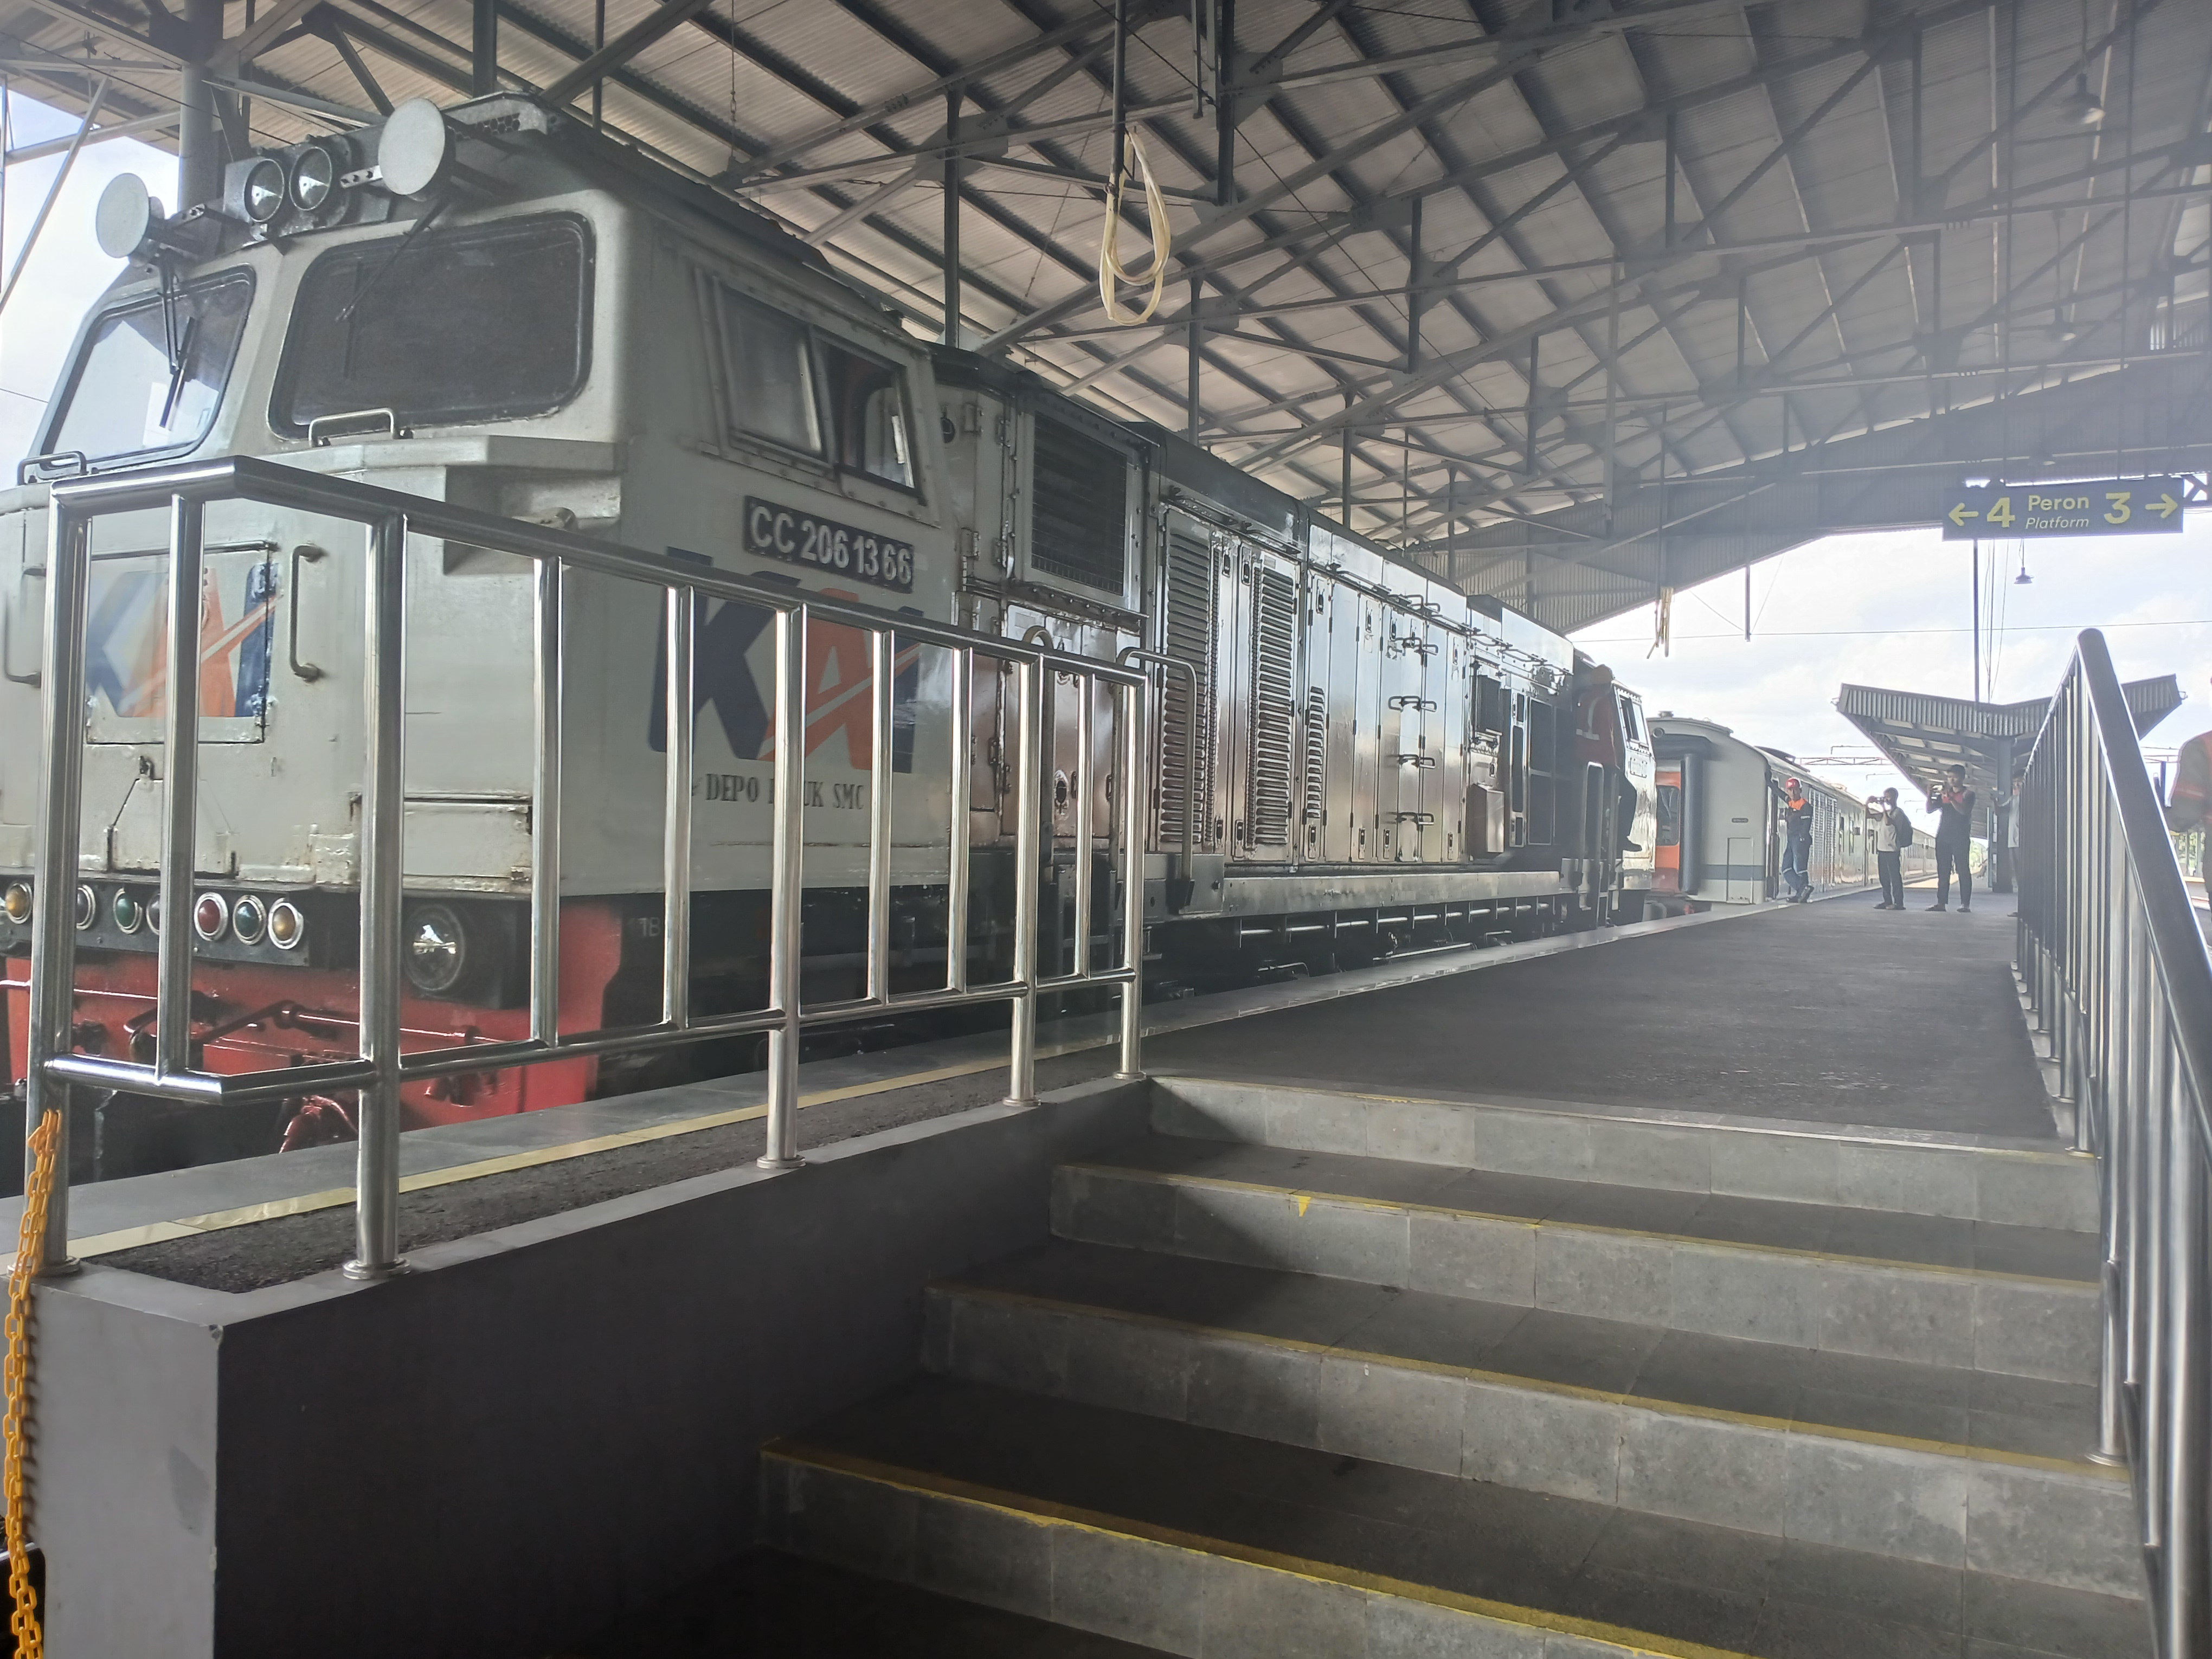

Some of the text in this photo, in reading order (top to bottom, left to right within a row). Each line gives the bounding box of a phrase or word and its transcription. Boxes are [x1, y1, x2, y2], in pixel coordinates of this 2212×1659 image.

[1986, 497, 2016, 528] 4
[2028, 494, 2089, 512] Peron
[2104, 492, 2131, 524] 3
[750, 506, 796, 554] CC
[800, 520, 850, 568] 206
[2025, 517, 2089, 530] Platform
[648, 546, 923, 774] KAI
[705, 773, 758, 802] DEPO
[832, 783, 864, 809] SMC
